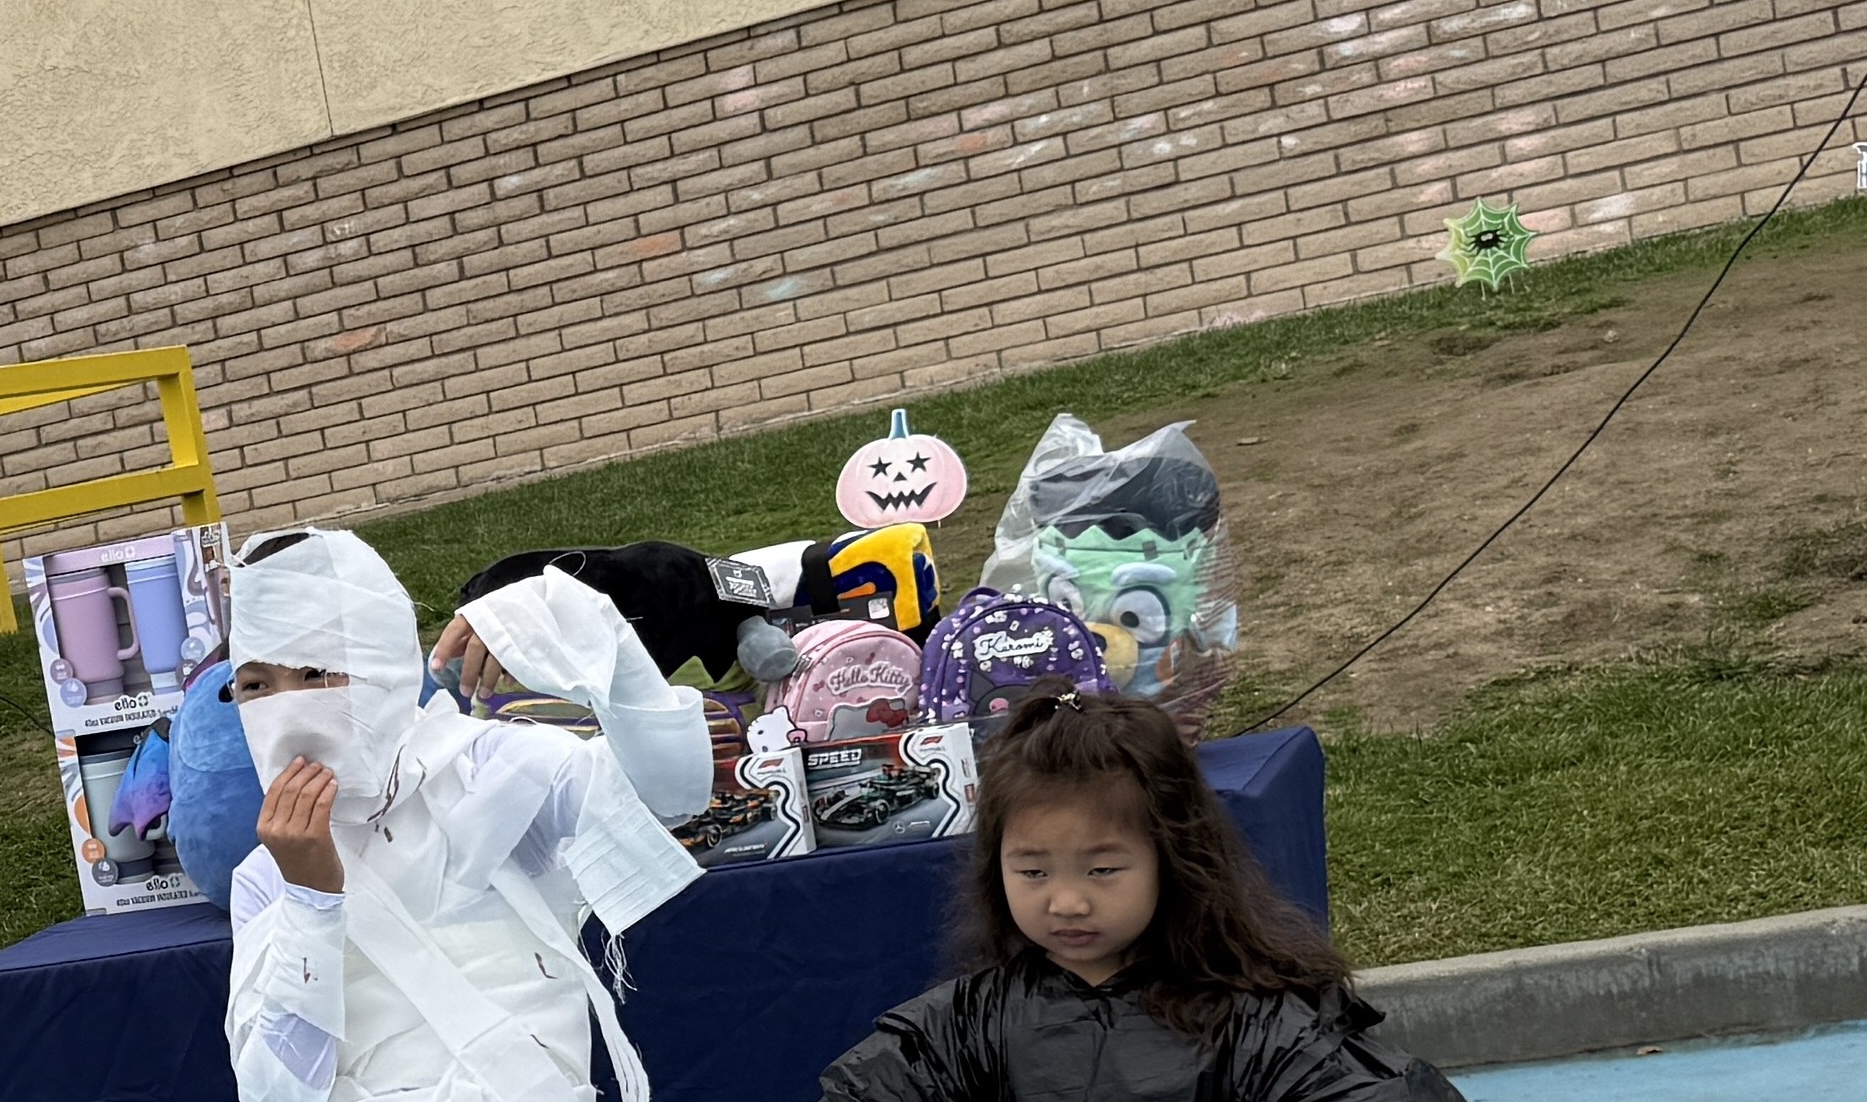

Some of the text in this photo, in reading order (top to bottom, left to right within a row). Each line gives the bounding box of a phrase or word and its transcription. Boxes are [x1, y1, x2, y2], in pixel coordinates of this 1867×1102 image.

[830, 664, 912, 694] Hello Kitty
[807, 748, 862, 766] SPEED
